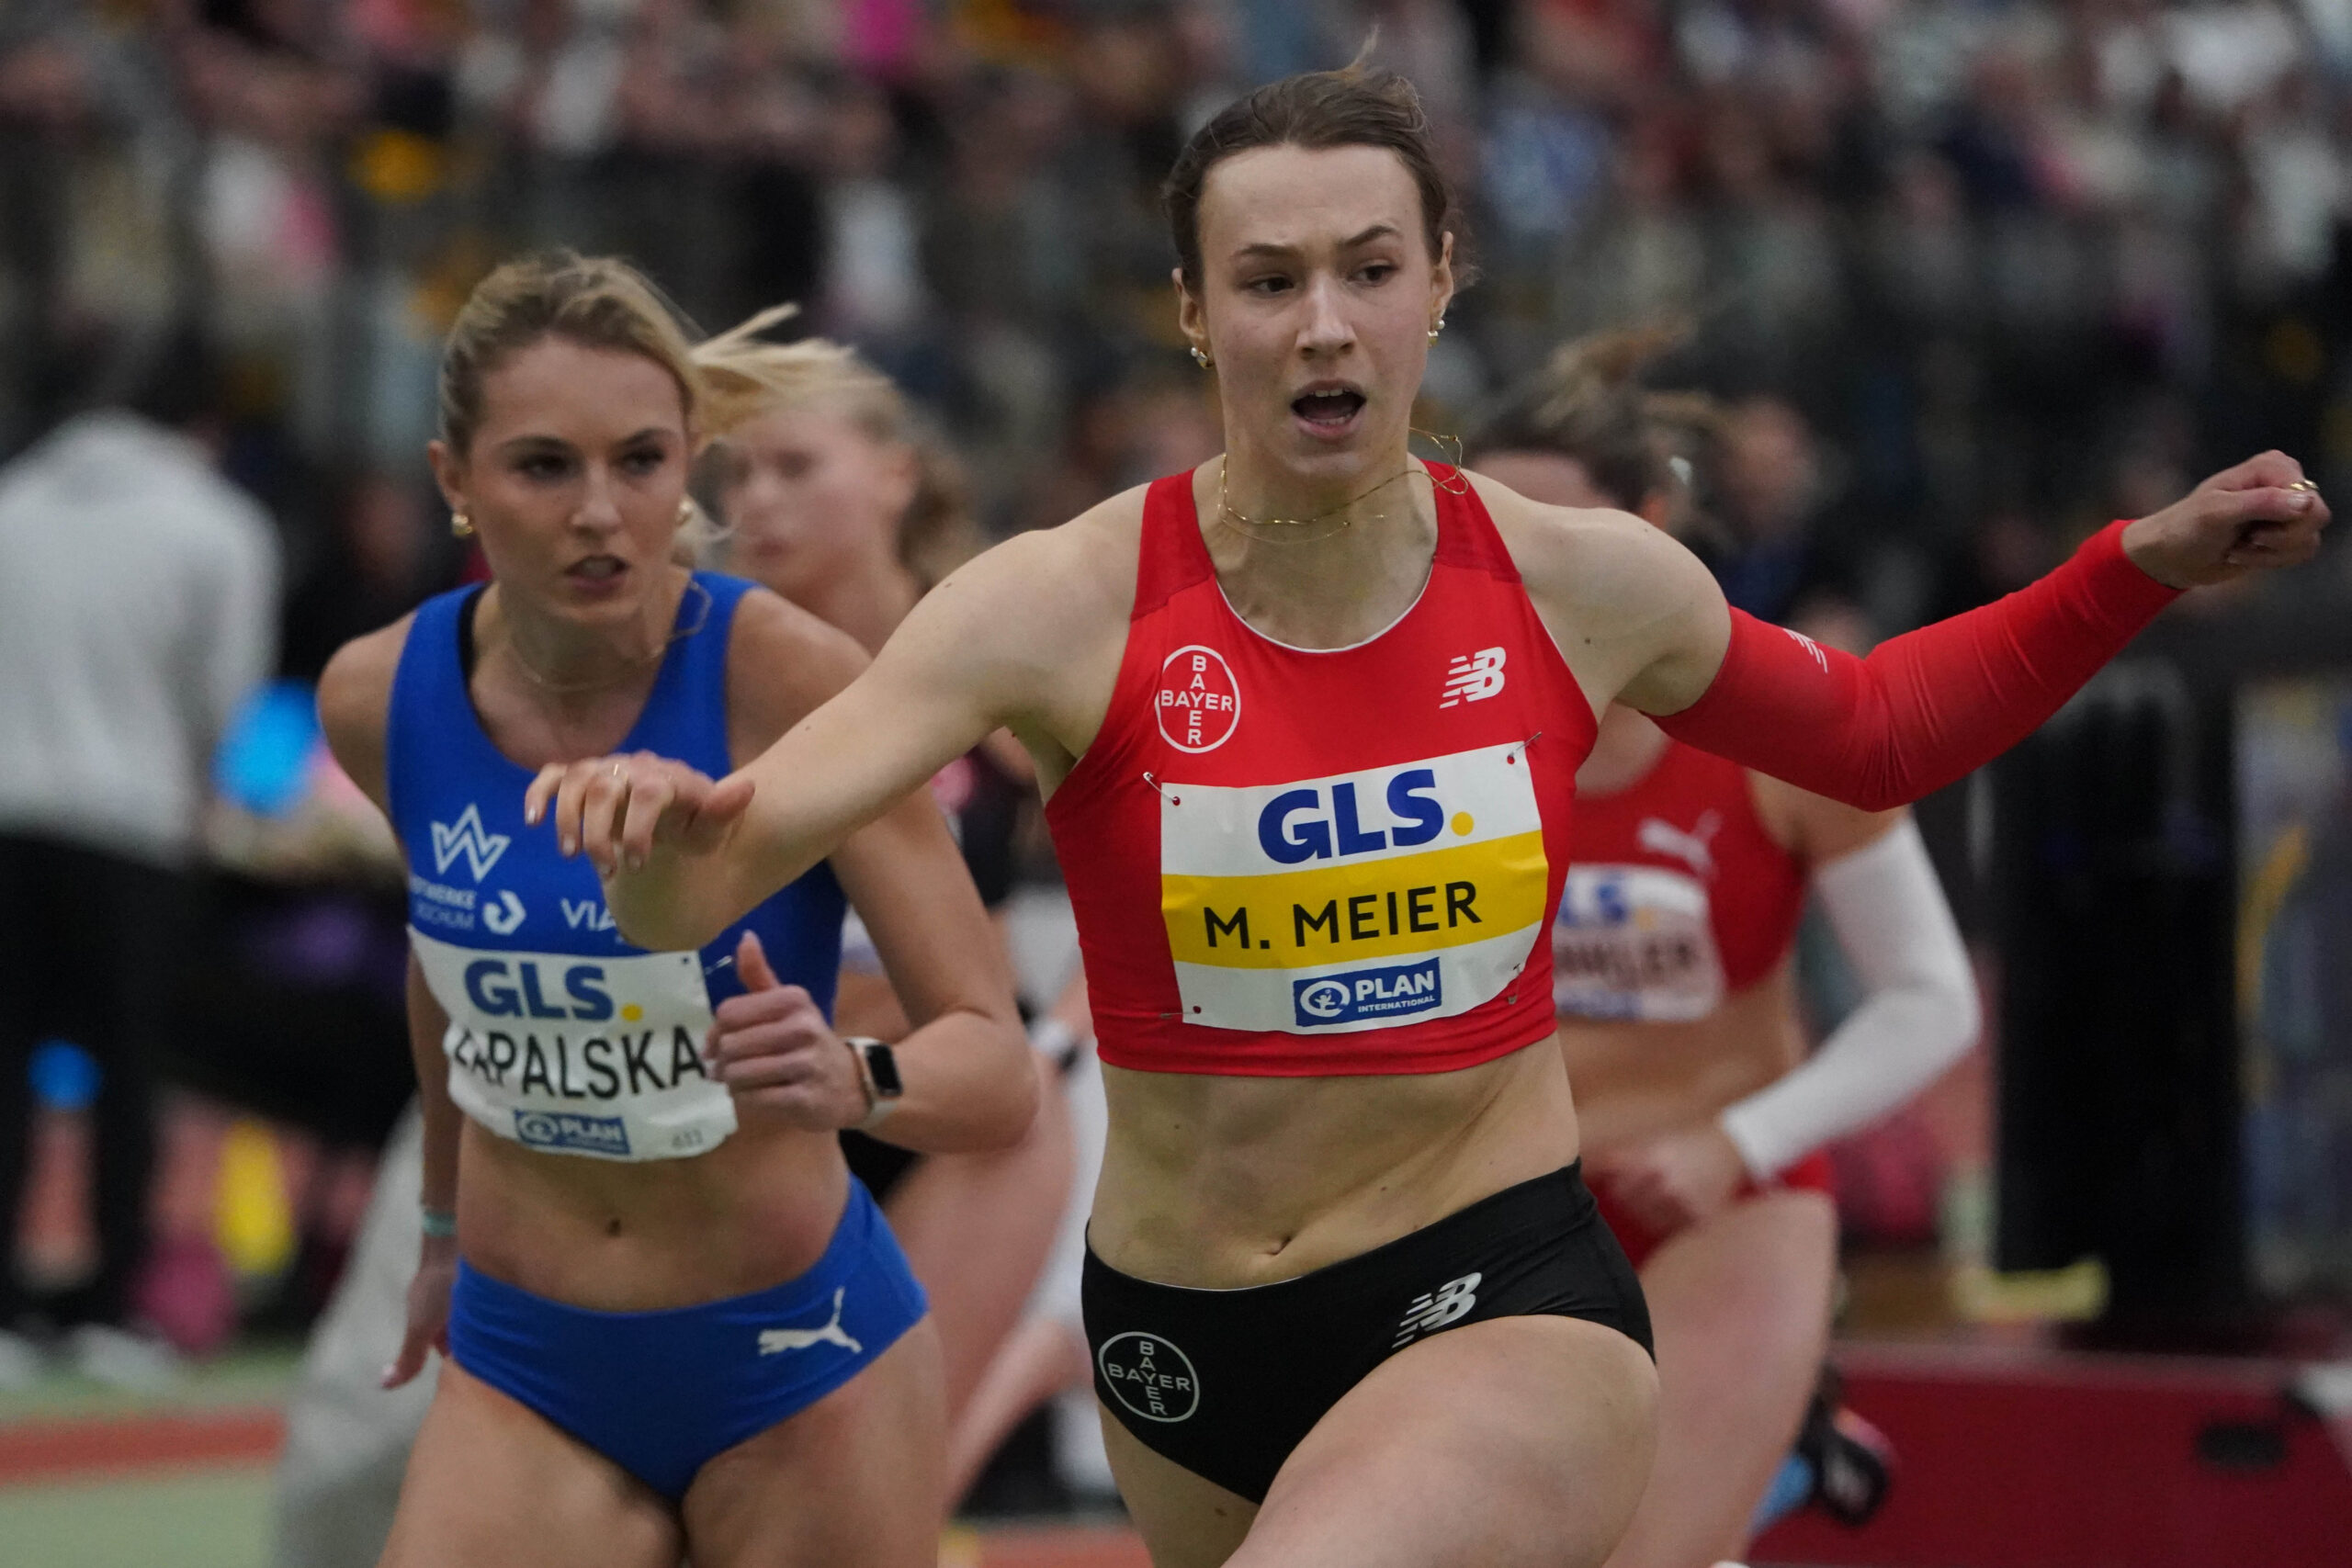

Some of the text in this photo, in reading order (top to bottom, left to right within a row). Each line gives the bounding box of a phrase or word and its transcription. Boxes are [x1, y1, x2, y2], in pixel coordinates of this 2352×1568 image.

[1160, 690, 1233, 712] BAYER
[1187, 654, 1207, 746] BAYER
[1204, 881, 1483, 950] M. MEIER
[1355, 970, 1434, 1001] PLAN
[1358, 995, 1436, 1013] INTERNATIONAL
[1108, 1362, 1192, 1392] BAYER
[1139, 1340, 1169, 1416] BAYER
